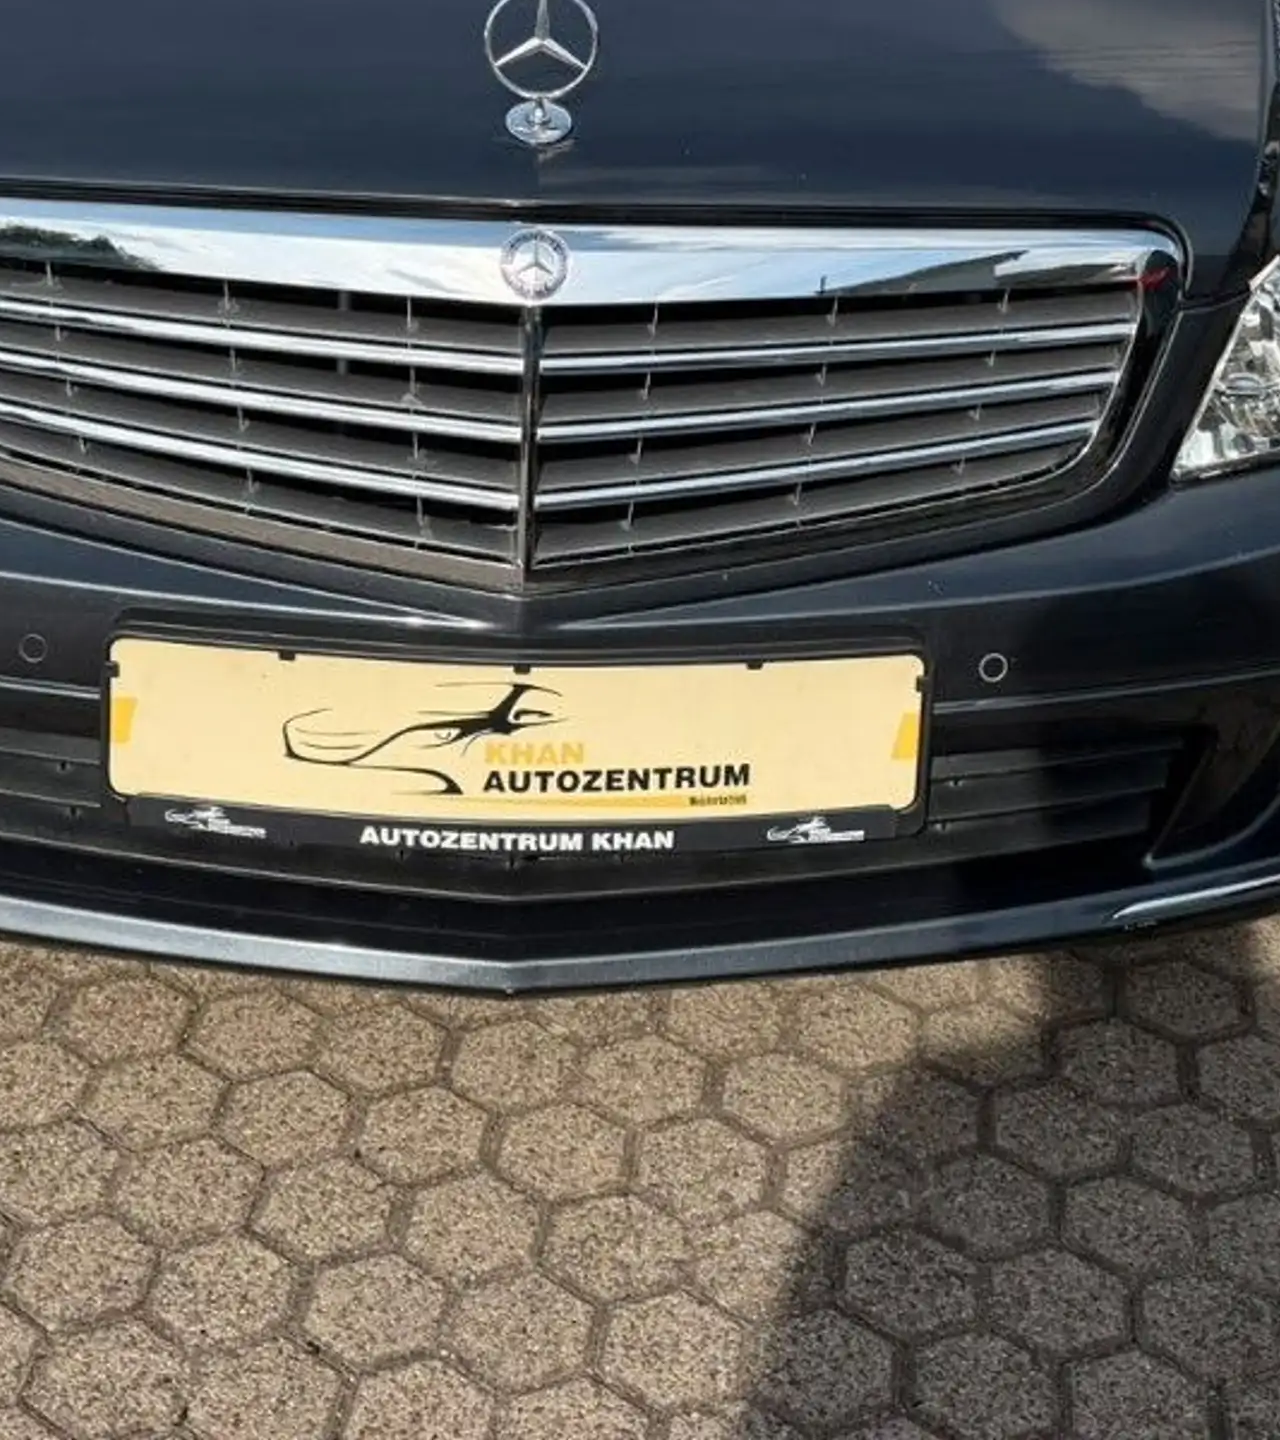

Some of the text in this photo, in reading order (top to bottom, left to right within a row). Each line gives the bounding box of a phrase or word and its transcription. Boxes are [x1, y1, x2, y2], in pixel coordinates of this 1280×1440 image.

[485, 741, 584, 765] KHAN
[483, 763, 751, 793] AUTOZENTRUM
[360, 826, 675, 851] AUTOZENTRUM KHAN
